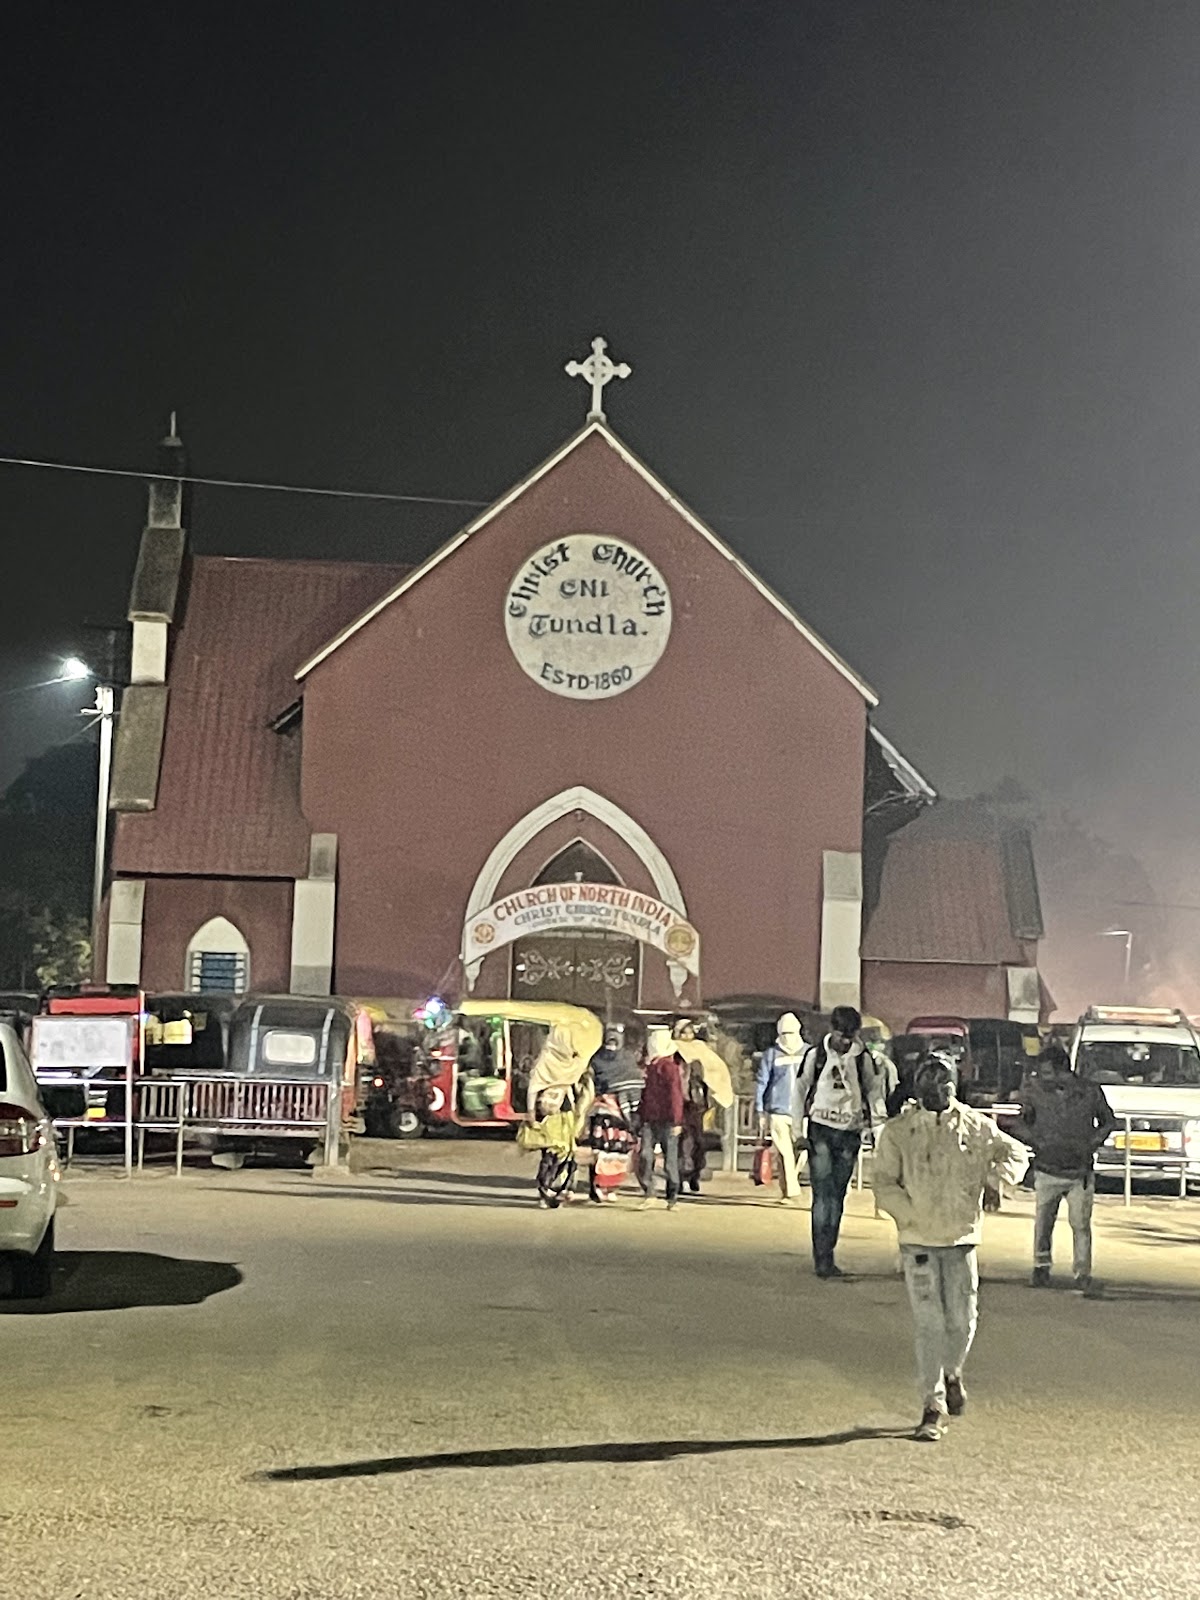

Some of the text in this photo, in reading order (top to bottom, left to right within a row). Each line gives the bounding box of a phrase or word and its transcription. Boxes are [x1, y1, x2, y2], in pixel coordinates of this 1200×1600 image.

[508, 543, 666, 618] Christ Church
[493, 887, 557, 921] CHURCH
[560, 886, 577, 903] OF
[579, 886, 630, 907] NORTH
[631, 895, 671, 927] INDIA
[514, 904, 561, 926] CHRIST
